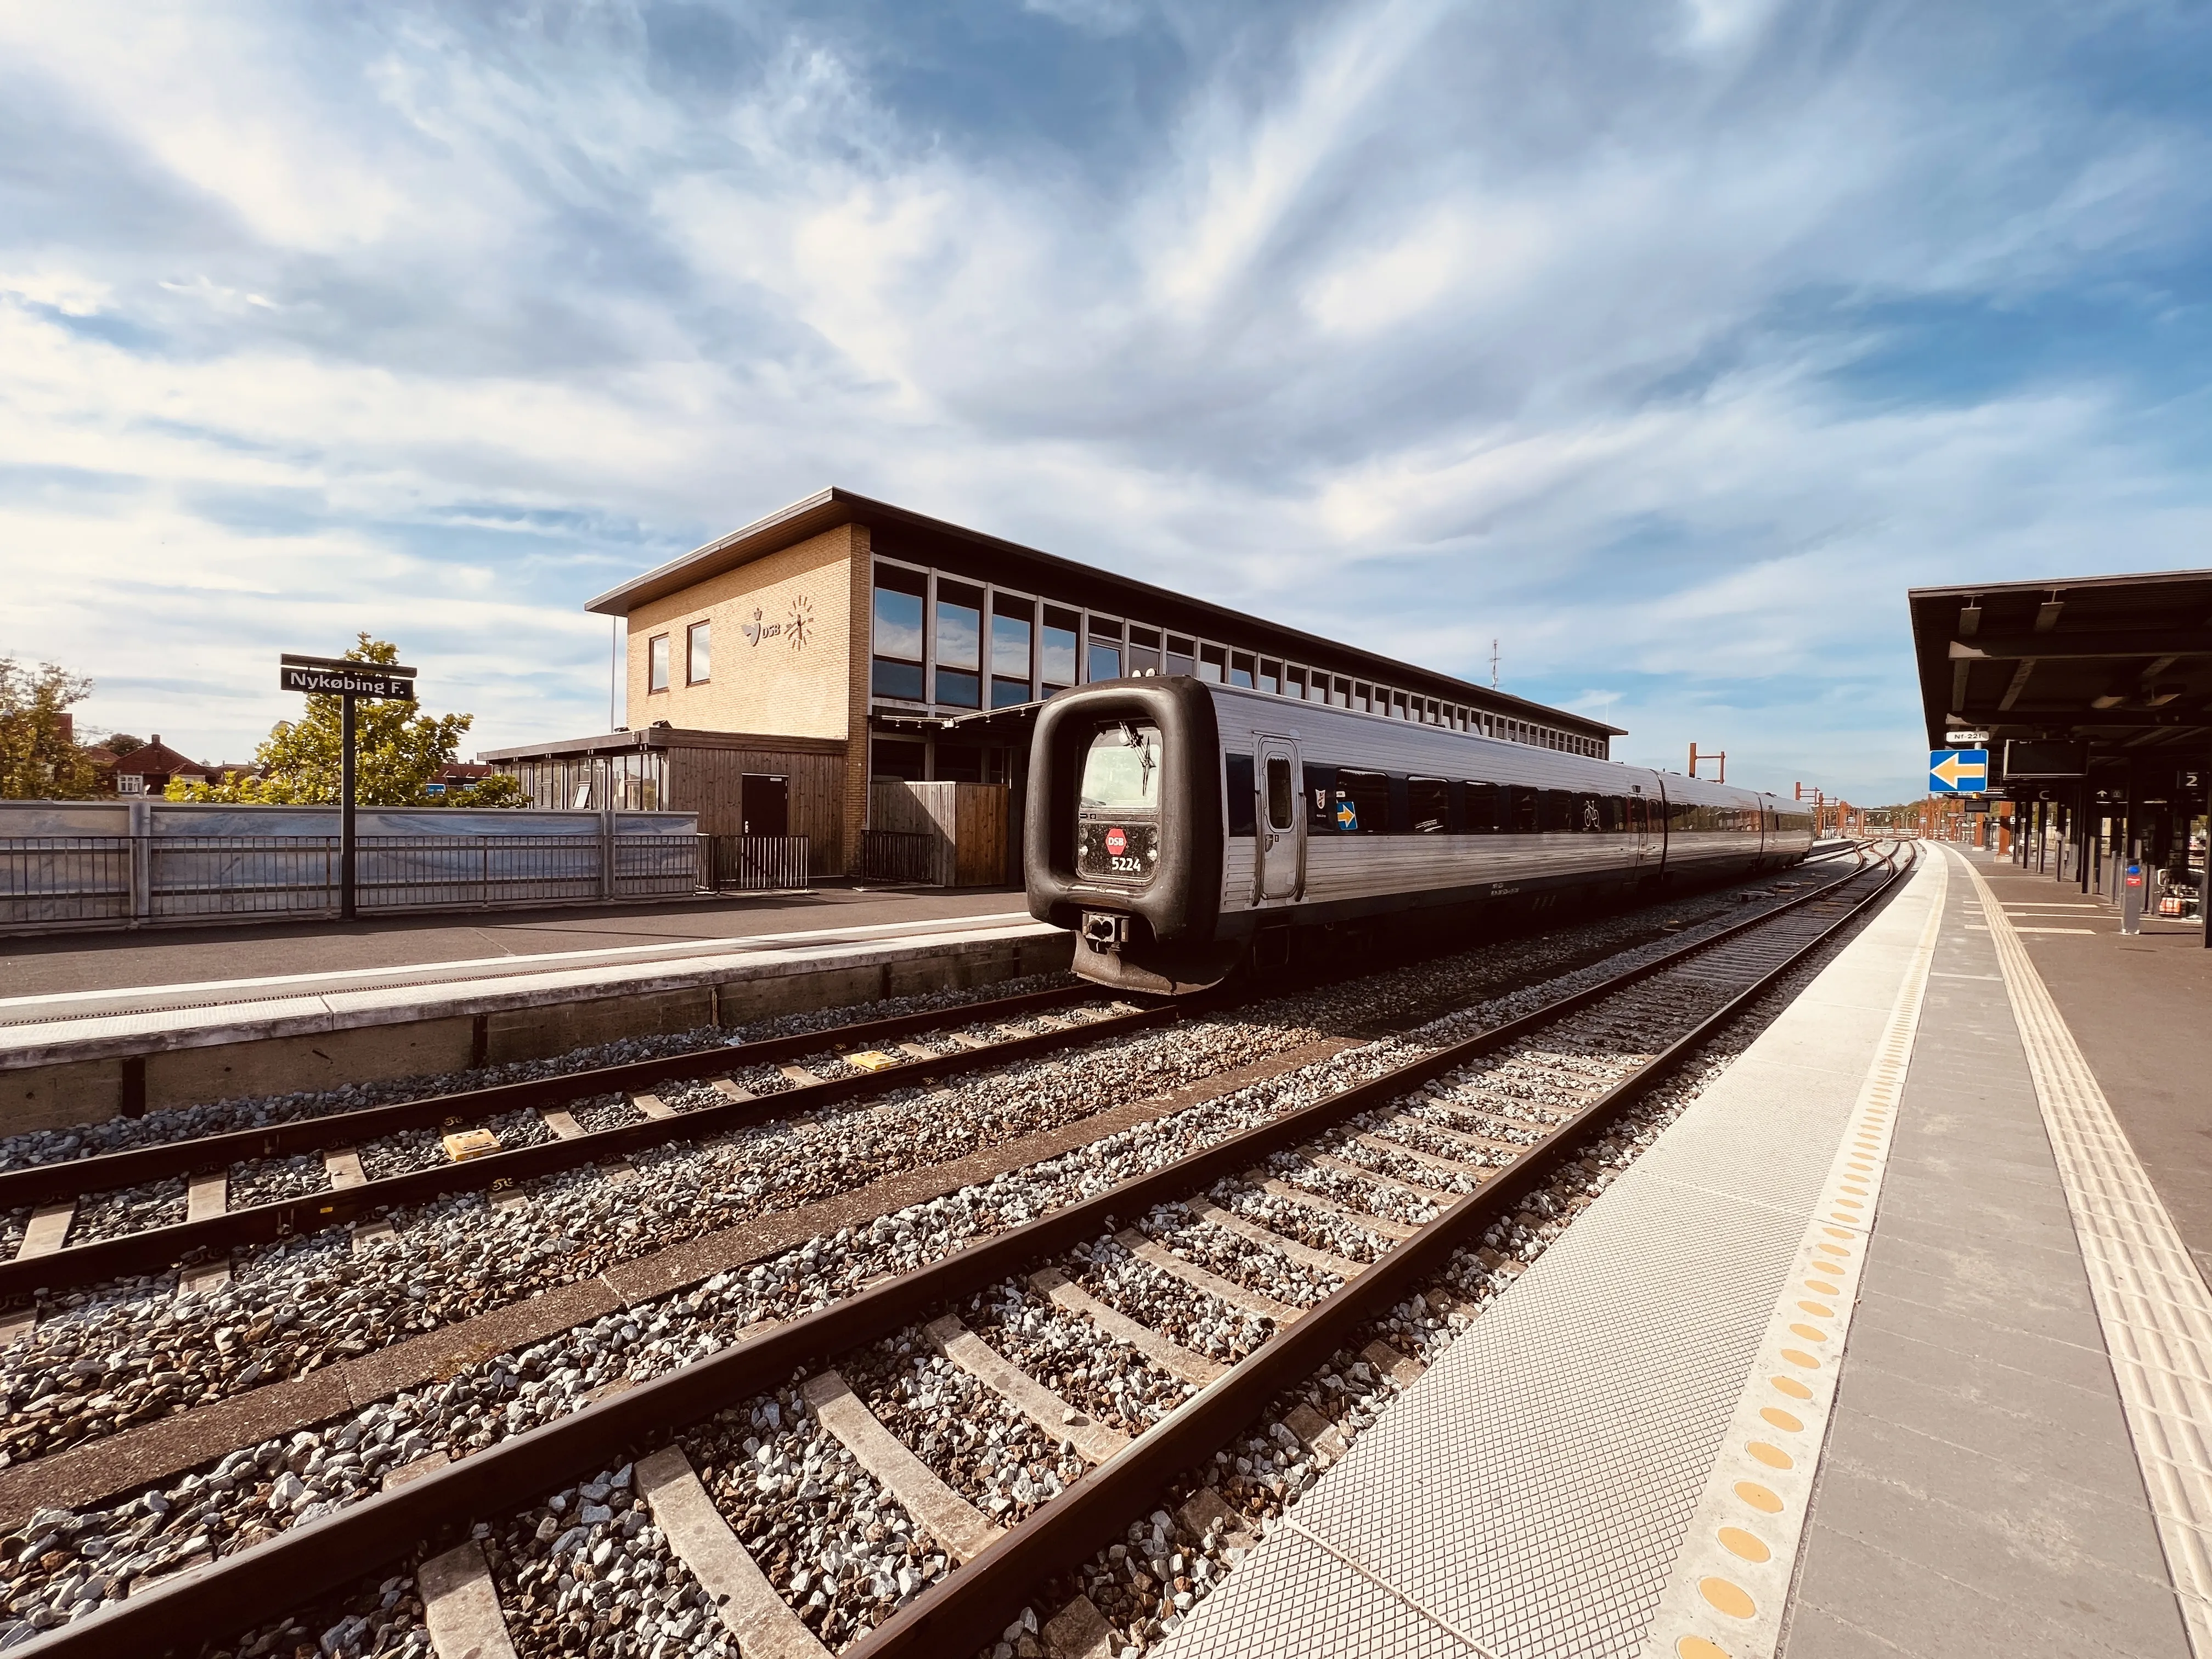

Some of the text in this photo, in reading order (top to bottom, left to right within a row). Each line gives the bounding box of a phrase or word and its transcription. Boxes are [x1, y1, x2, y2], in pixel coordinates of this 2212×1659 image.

[763, 624, 780, 639] DSB
[290, 672, 404, 695] Nykøbing F.
[2185, 775, 2198, 787] 2
[1108, 837, 1124, 847] DSB
[1111, 857, 1141, 872] 5224
